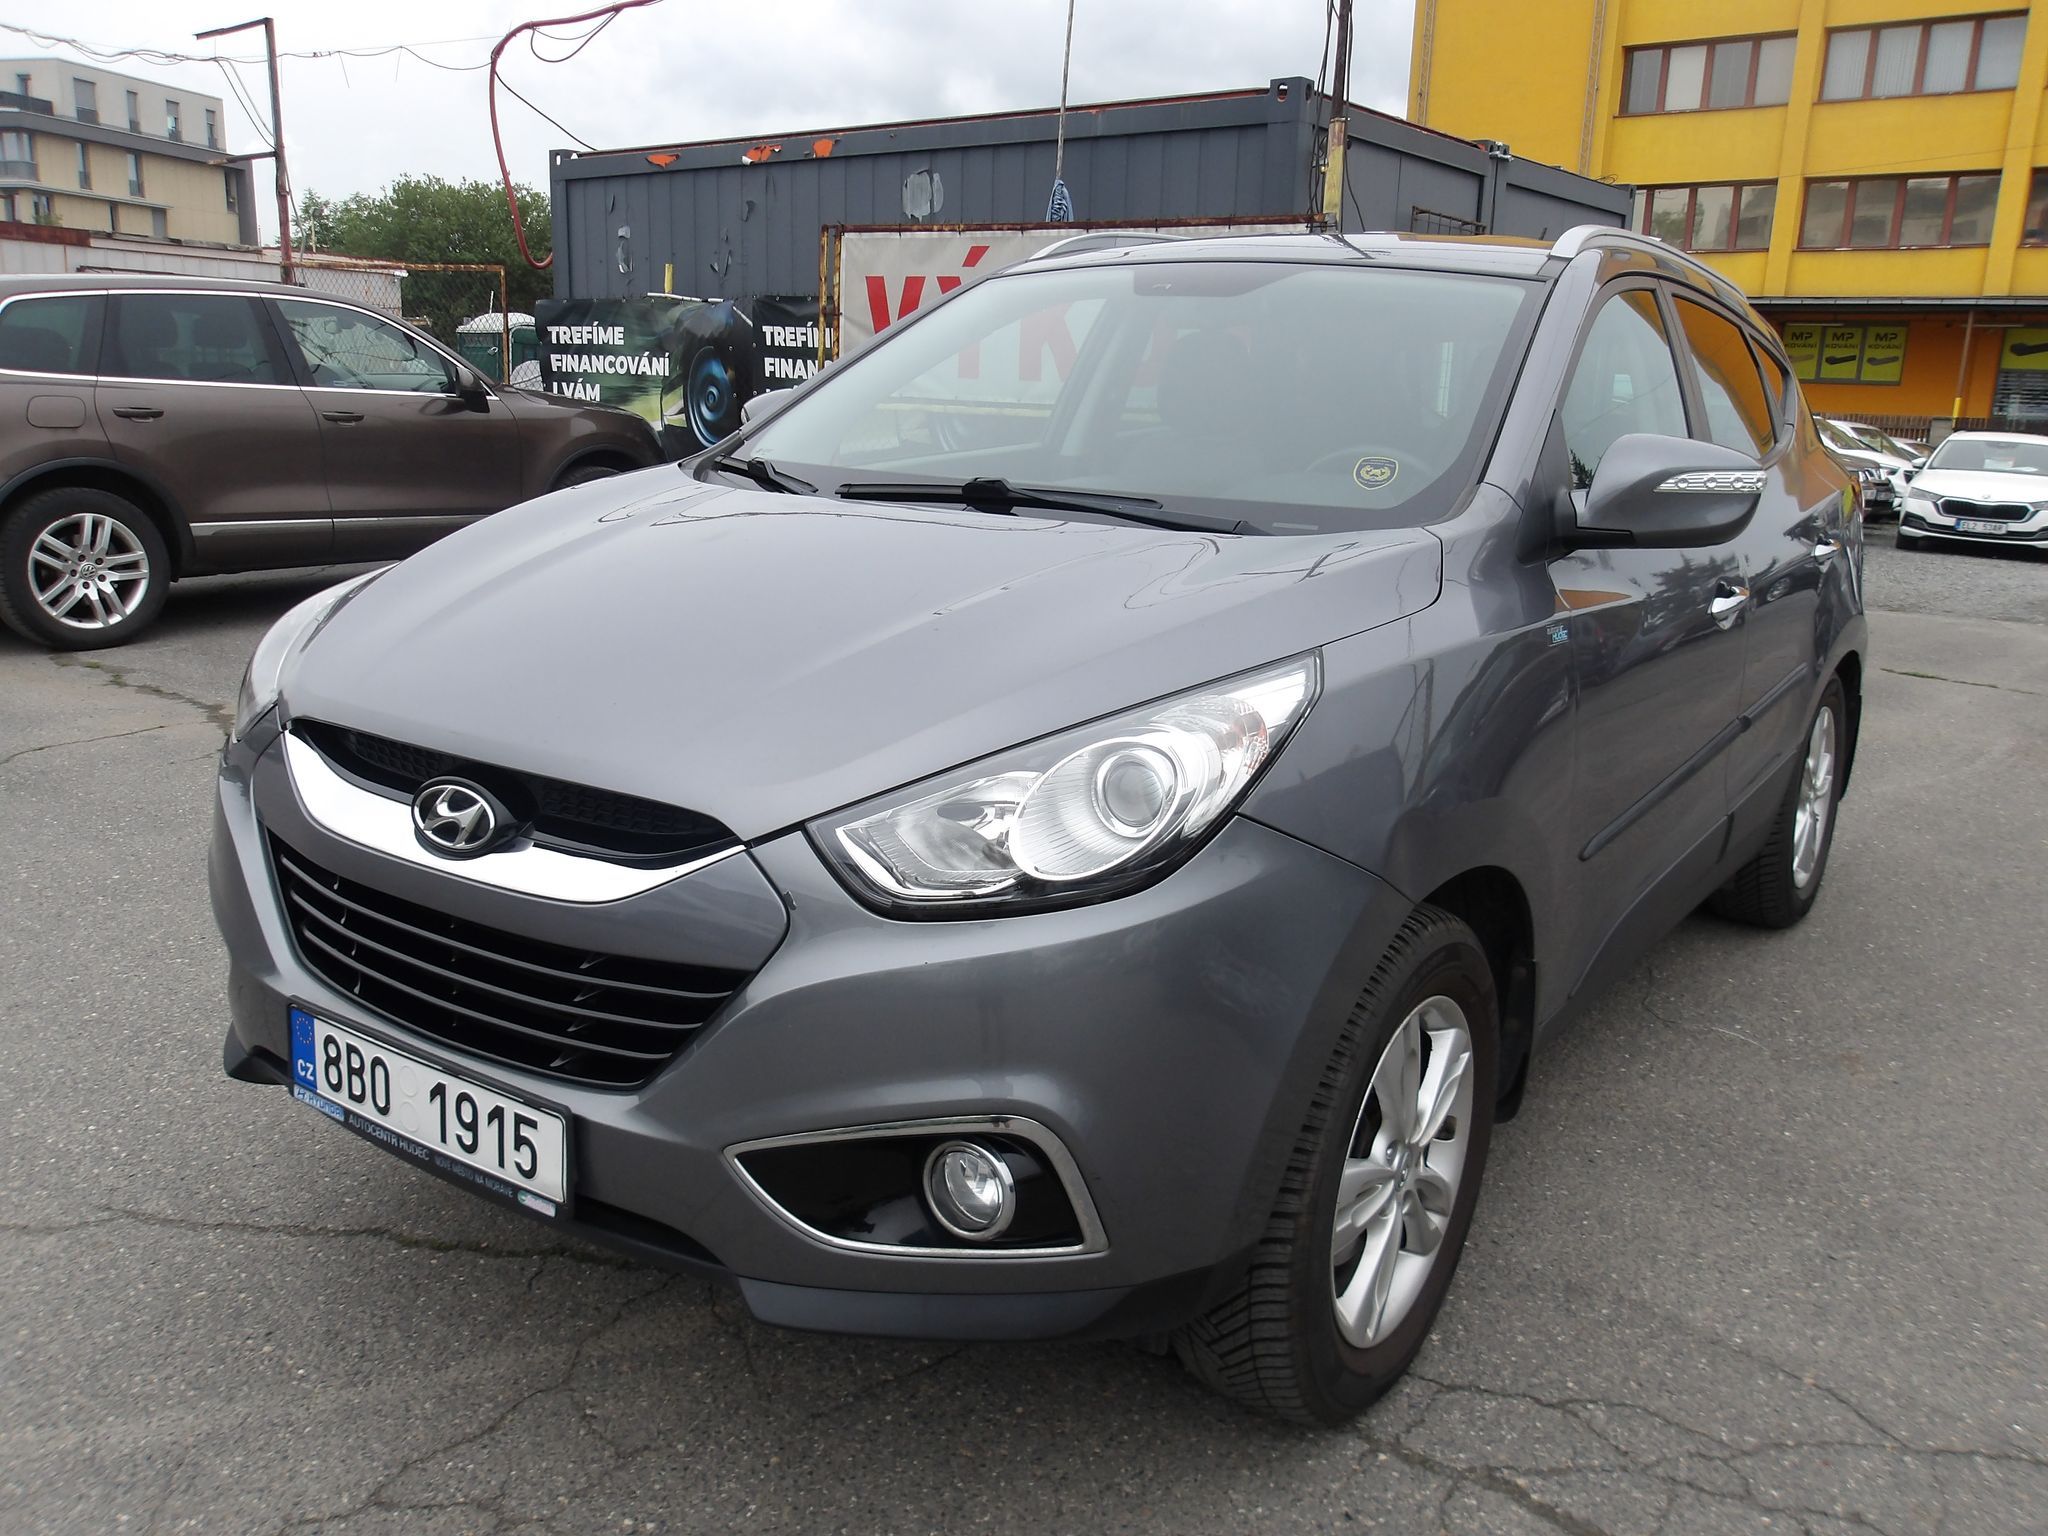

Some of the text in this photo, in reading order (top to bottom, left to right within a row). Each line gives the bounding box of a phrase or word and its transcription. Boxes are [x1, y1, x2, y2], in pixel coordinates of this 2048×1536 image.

[547, 321, 625, 346] TREFÍME
[762, 321, 835, 349] TREFÍM
[1791, 331, 1813, 341] MP
[1832, 332, 1855, 342] MP
[1874, 332, 1898, 342] MP
[550, 351, 670, 377] FINANCOVÁNÍ
[561, 378, 601, 402] VÁM
[297, 1058, 315, 1081] CZ
[323, 1033, 539, 1180] 8B0 1915
[349, 1114, 399, 1147] AUTOCENTR
[399, 1138, 430, 1161] HUDEC
